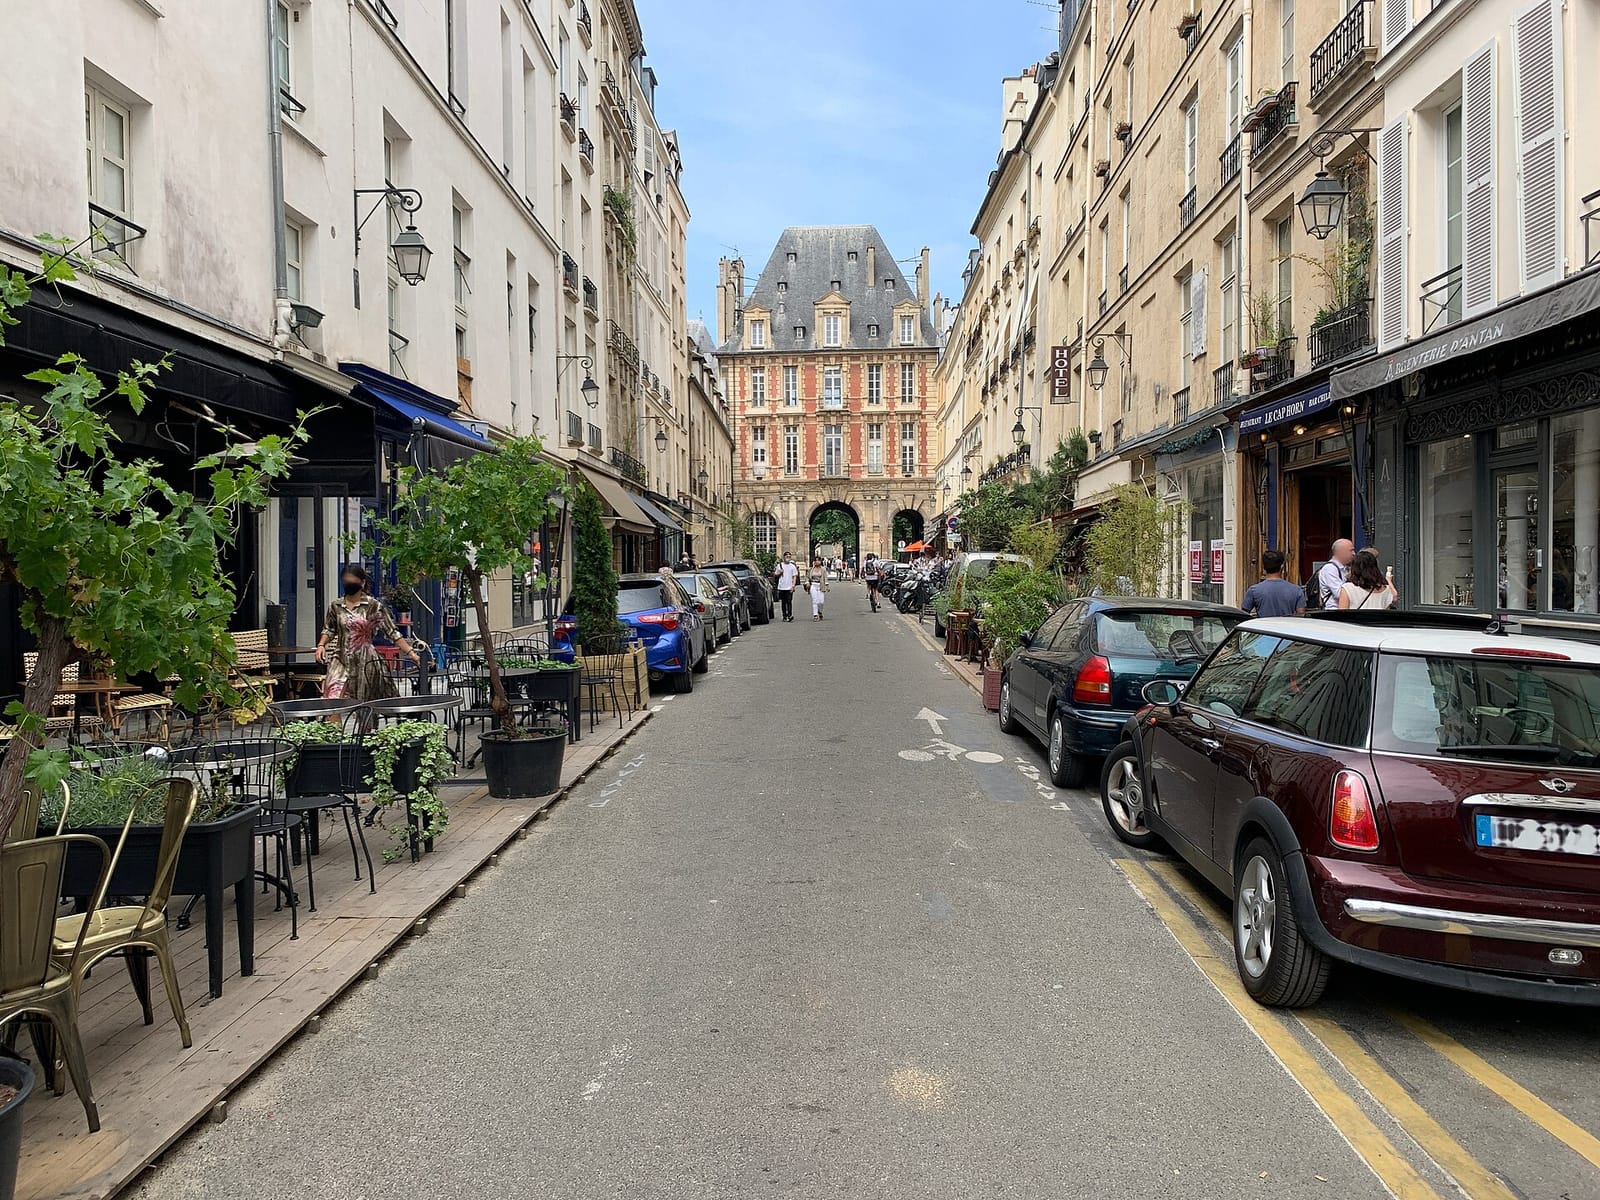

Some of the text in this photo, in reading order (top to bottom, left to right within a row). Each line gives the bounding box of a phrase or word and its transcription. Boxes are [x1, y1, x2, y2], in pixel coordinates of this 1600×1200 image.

[1450, 323, 1504, 352] D'ANTAN
[1054, 349, 1068, 397] HOTEL
[1264, 413, 1273, 424] LE
[1273, 406, 1287, 422] CAP
[1287, 401, 1305, 417] HORN
